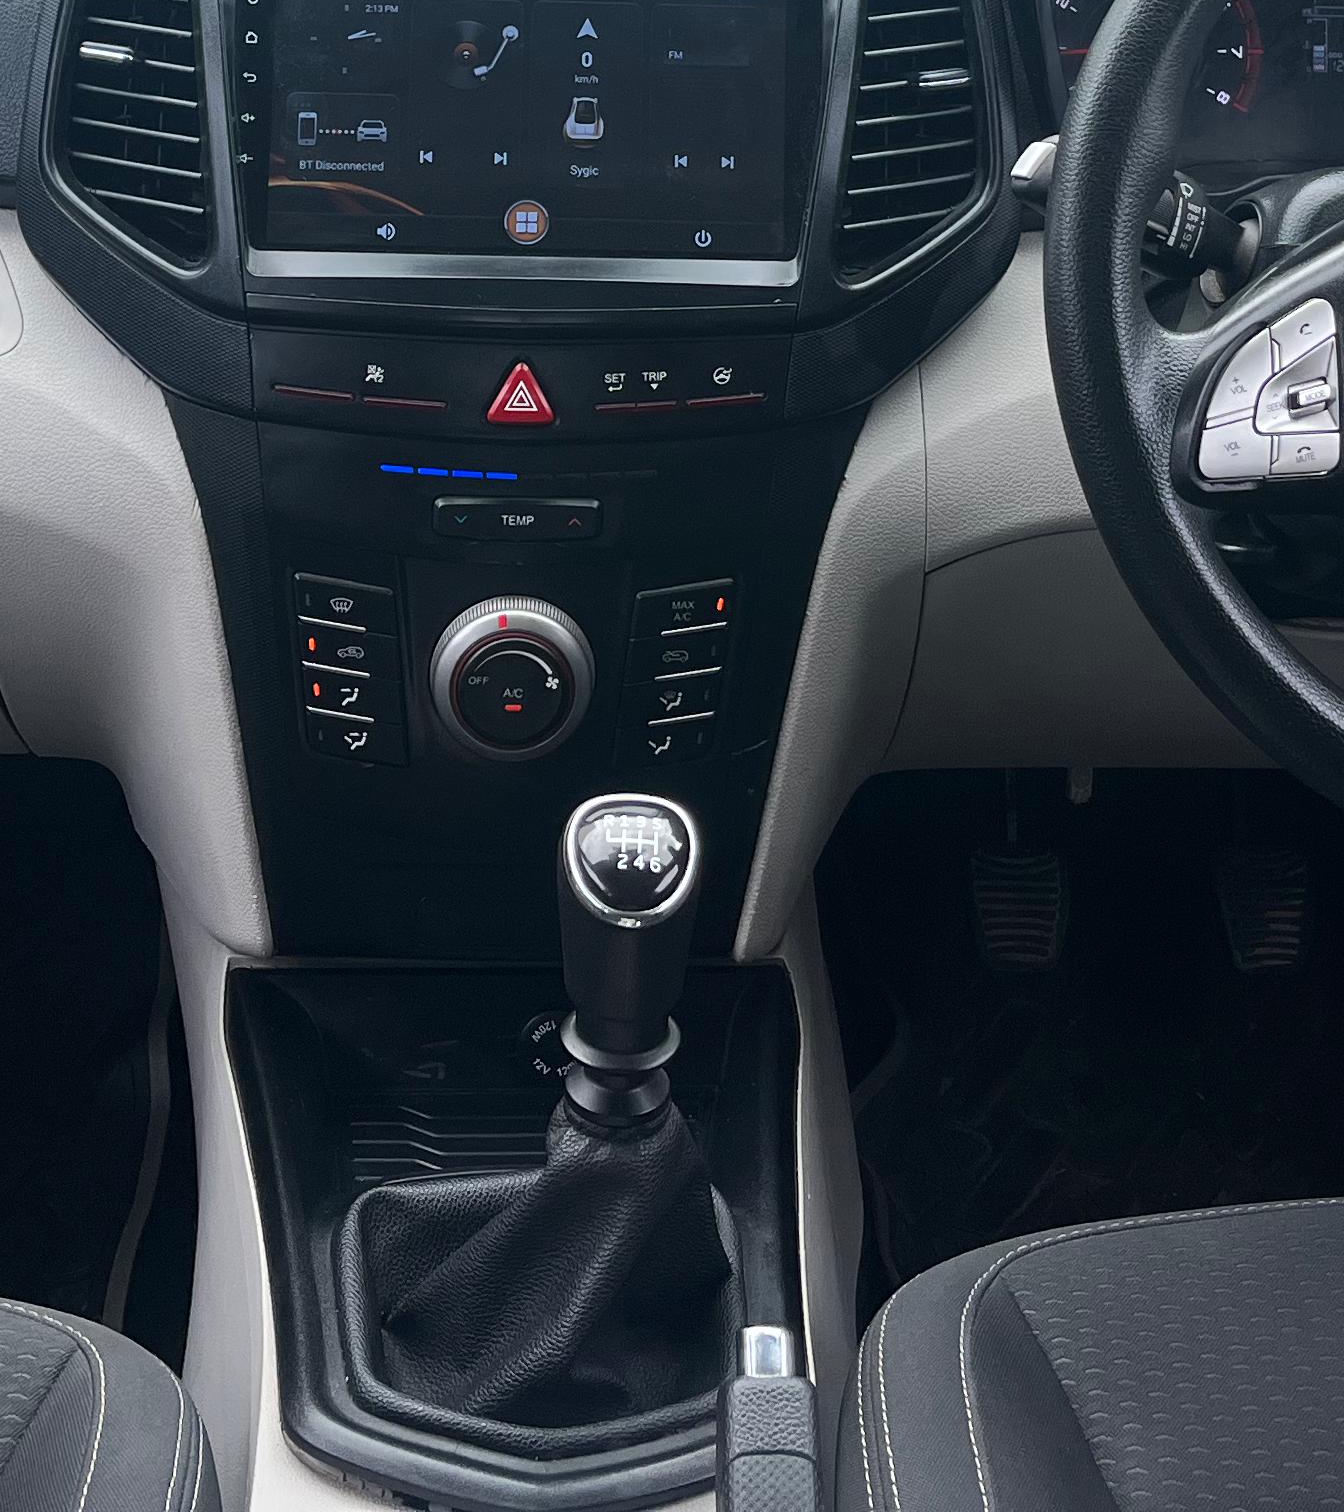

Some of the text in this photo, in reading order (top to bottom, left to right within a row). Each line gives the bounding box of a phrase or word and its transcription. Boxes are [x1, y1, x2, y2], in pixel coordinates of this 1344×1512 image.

[365, 4, 399, 14] 2:13 PM
[668, 50, 683, 60] FM
[1230, 45, 1244, 59] 7
[581, 51, 593, 68] 0
[574, 74, 599, 84] km/h
[1216, 90, 1231, 105] 8
[299, 160, 385, 172] BT Disconnected
[570, 164, 600, 178] Sygic
[603, 371, 668, 384] SET TRIP
[1229, 384, 1248, 395] VOL
[1305, 390, 1326, 402] MODE
[1265, 401, 1286, 412] SEEK
[1223, 440, 1242, 452] VOL
[1295, 452, 1317, 463] MUTE
[500, 514, 535, 526] TEMP
[671, 600, 695, 609] MAX
[673, 612, 692, 621] A/C
[468, 675, 490, 685] OFF
[502, 687, 524, 699] A/C
[617, 854, 662, 873] 2 4 6
[532, 1020, 557, 1043] 120W
[533, 1058, 552, 1075] 12V
